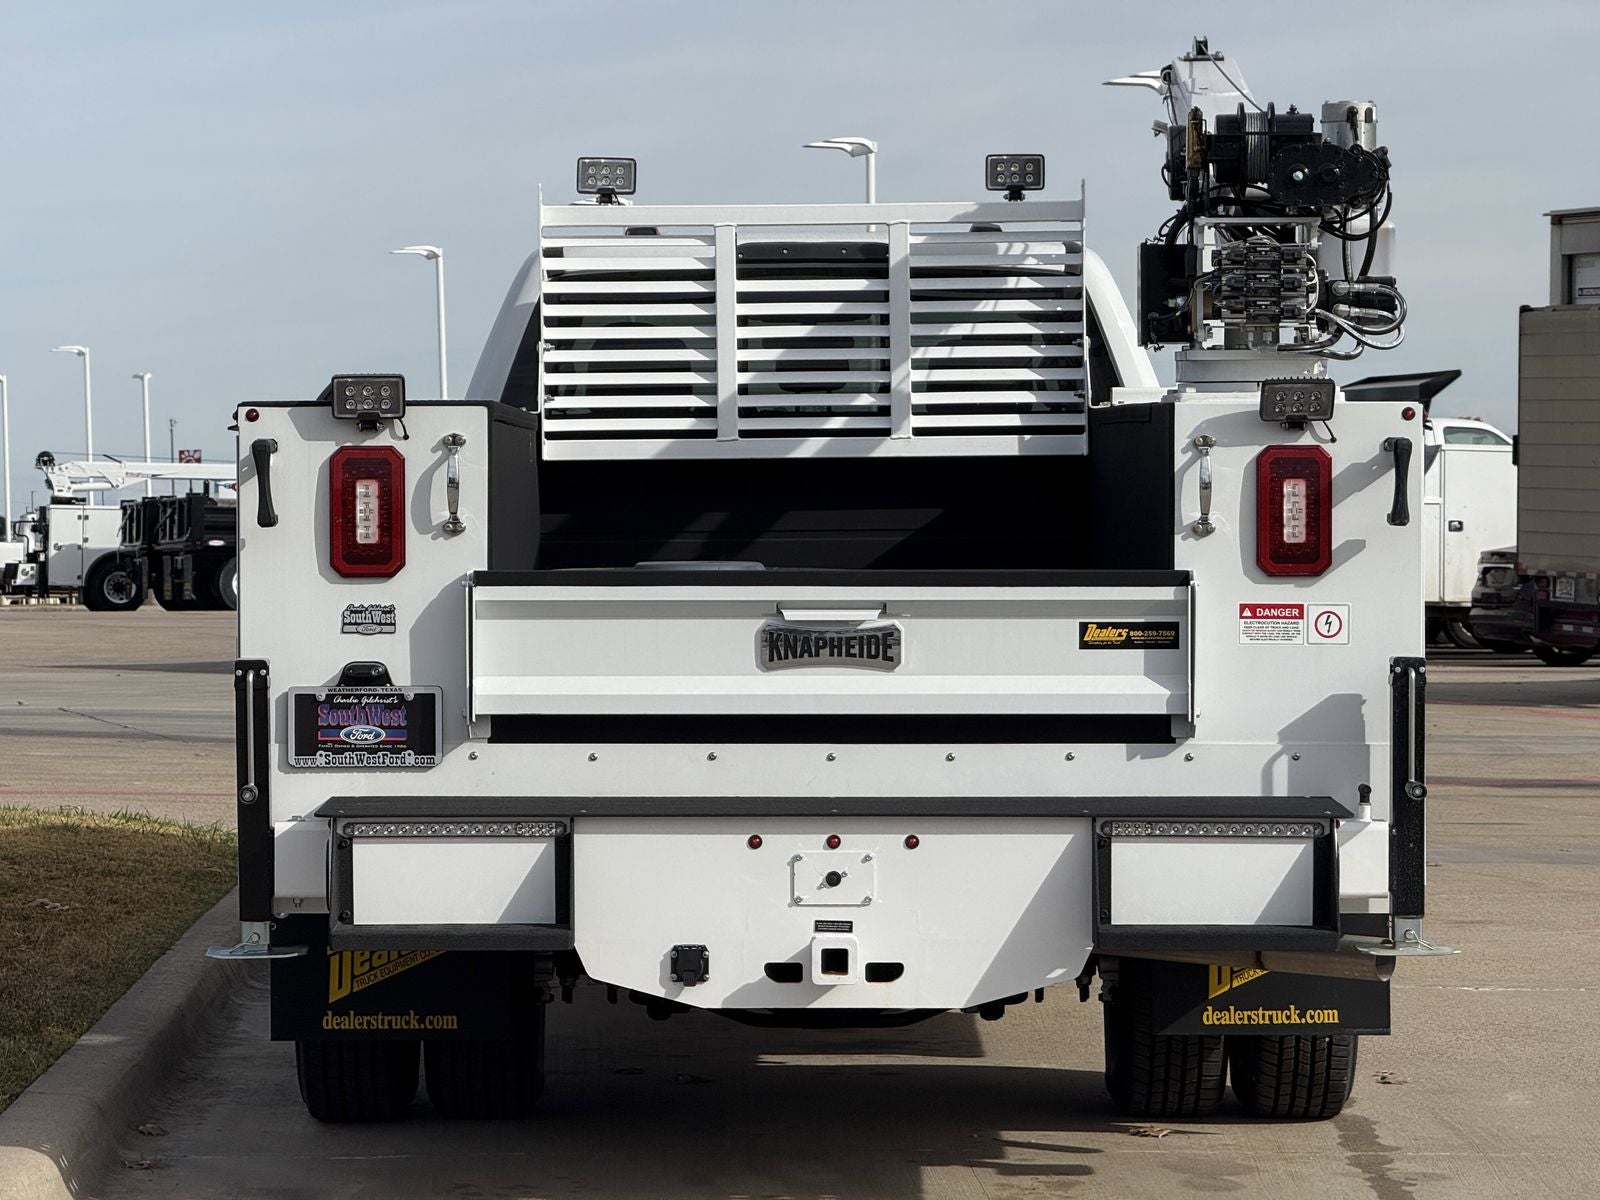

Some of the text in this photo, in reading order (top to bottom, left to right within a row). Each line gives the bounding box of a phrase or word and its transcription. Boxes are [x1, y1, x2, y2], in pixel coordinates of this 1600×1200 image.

[343, 610, 395, 623] SouthWest
[1256, 608, 1299, 617] DANGER
[1083, 623, 1129, 641] Dealers
[768, 631, 894, 662] KNAPHEIDE
[333, 695, 399, 706] Charlie Gilchrist's
[317, 704, 408, 726] SouthWest
[349, 728, 376, 740] Ford
[294, 753, 435, 767] www.SouthWestFord.com
[355, 970, 379, 988] TRUCK
[379, 953, 419, 977] EQUIPMENT
[322, 1009, 458, 1030] dealerstruck.com
[1202, 1004, 1339, 1025] dealerstruck.com
